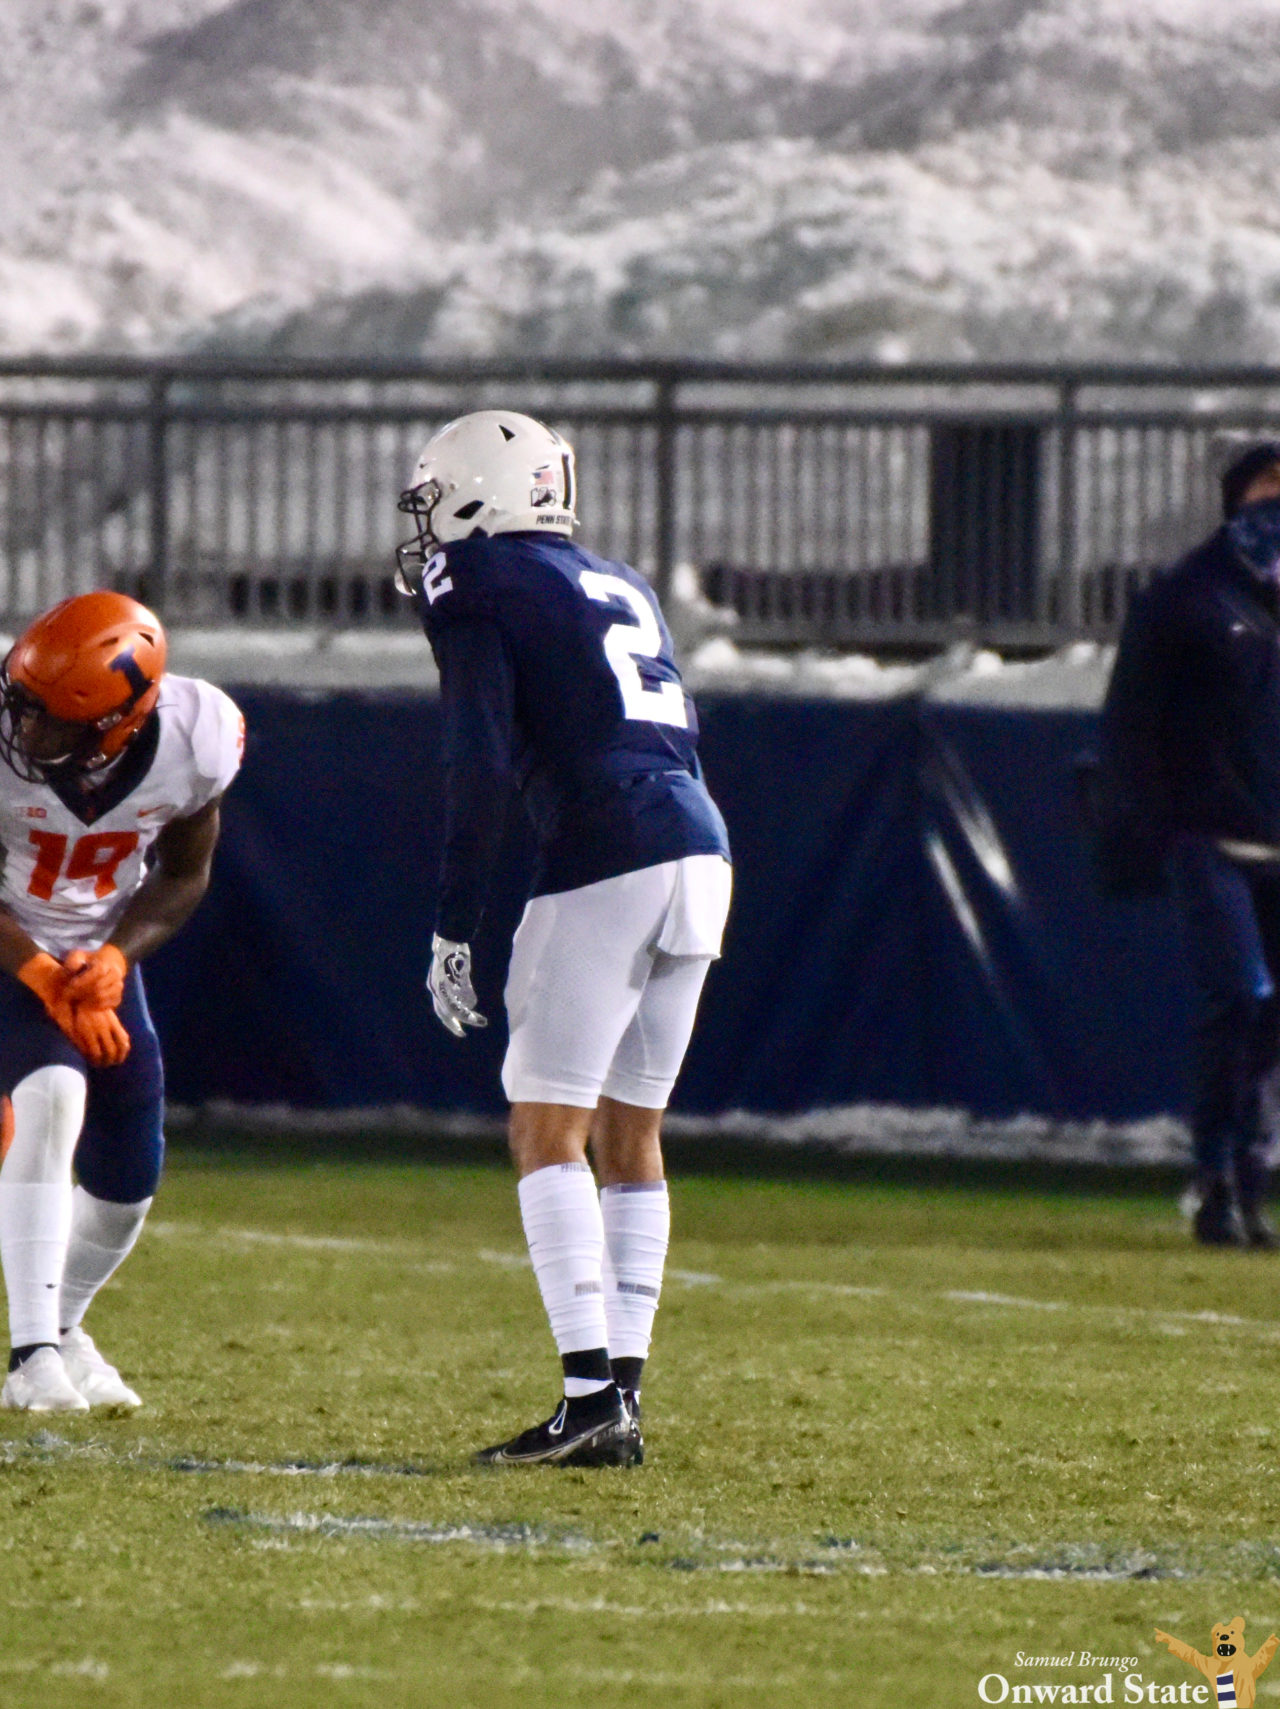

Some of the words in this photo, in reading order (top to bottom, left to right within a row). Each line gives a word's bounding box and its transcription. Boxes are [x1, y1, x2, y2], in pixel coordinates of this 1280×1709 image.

[536, 514, 554, 525] PENN
[421, 552, 453, 605] 2
[579, 570, 687, 728] 2
[27, 829, 139, 902] 19
